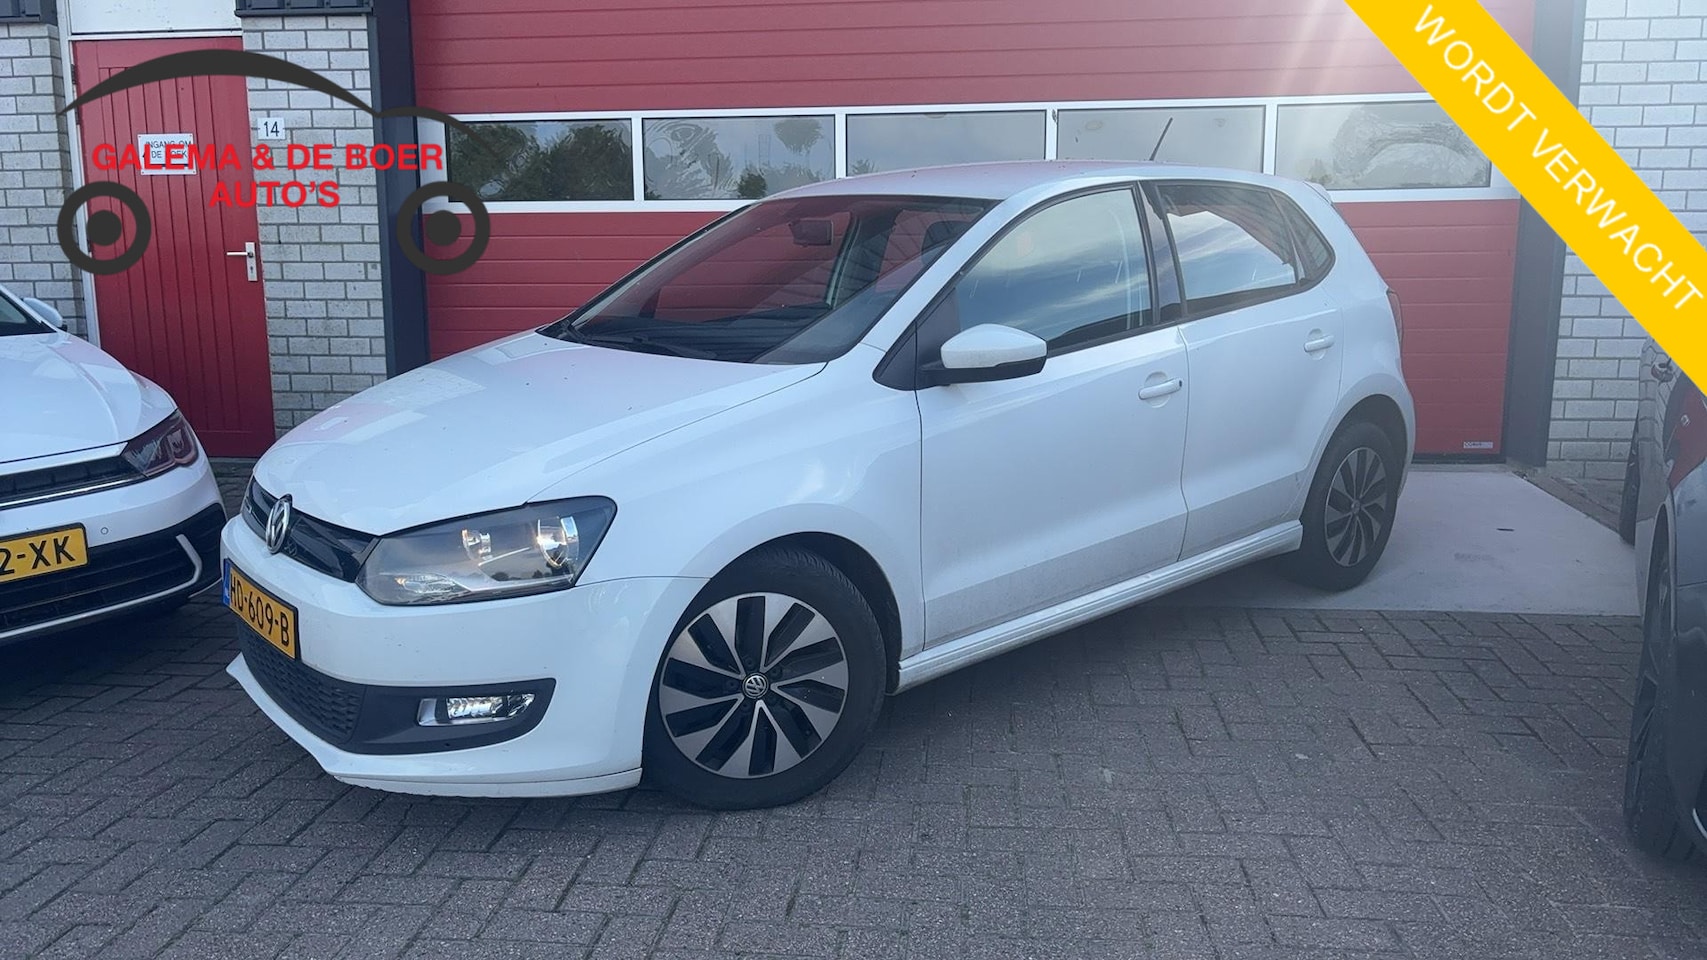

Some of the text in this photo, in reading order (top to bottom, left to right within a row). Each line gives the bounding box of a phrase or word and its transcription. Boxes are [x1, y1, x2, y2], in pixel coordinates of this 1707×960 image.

[263, 121, 280, 137] 14
[151, 150, 162, 159] DE
[230, 573, 290, 647] HD-609-B
